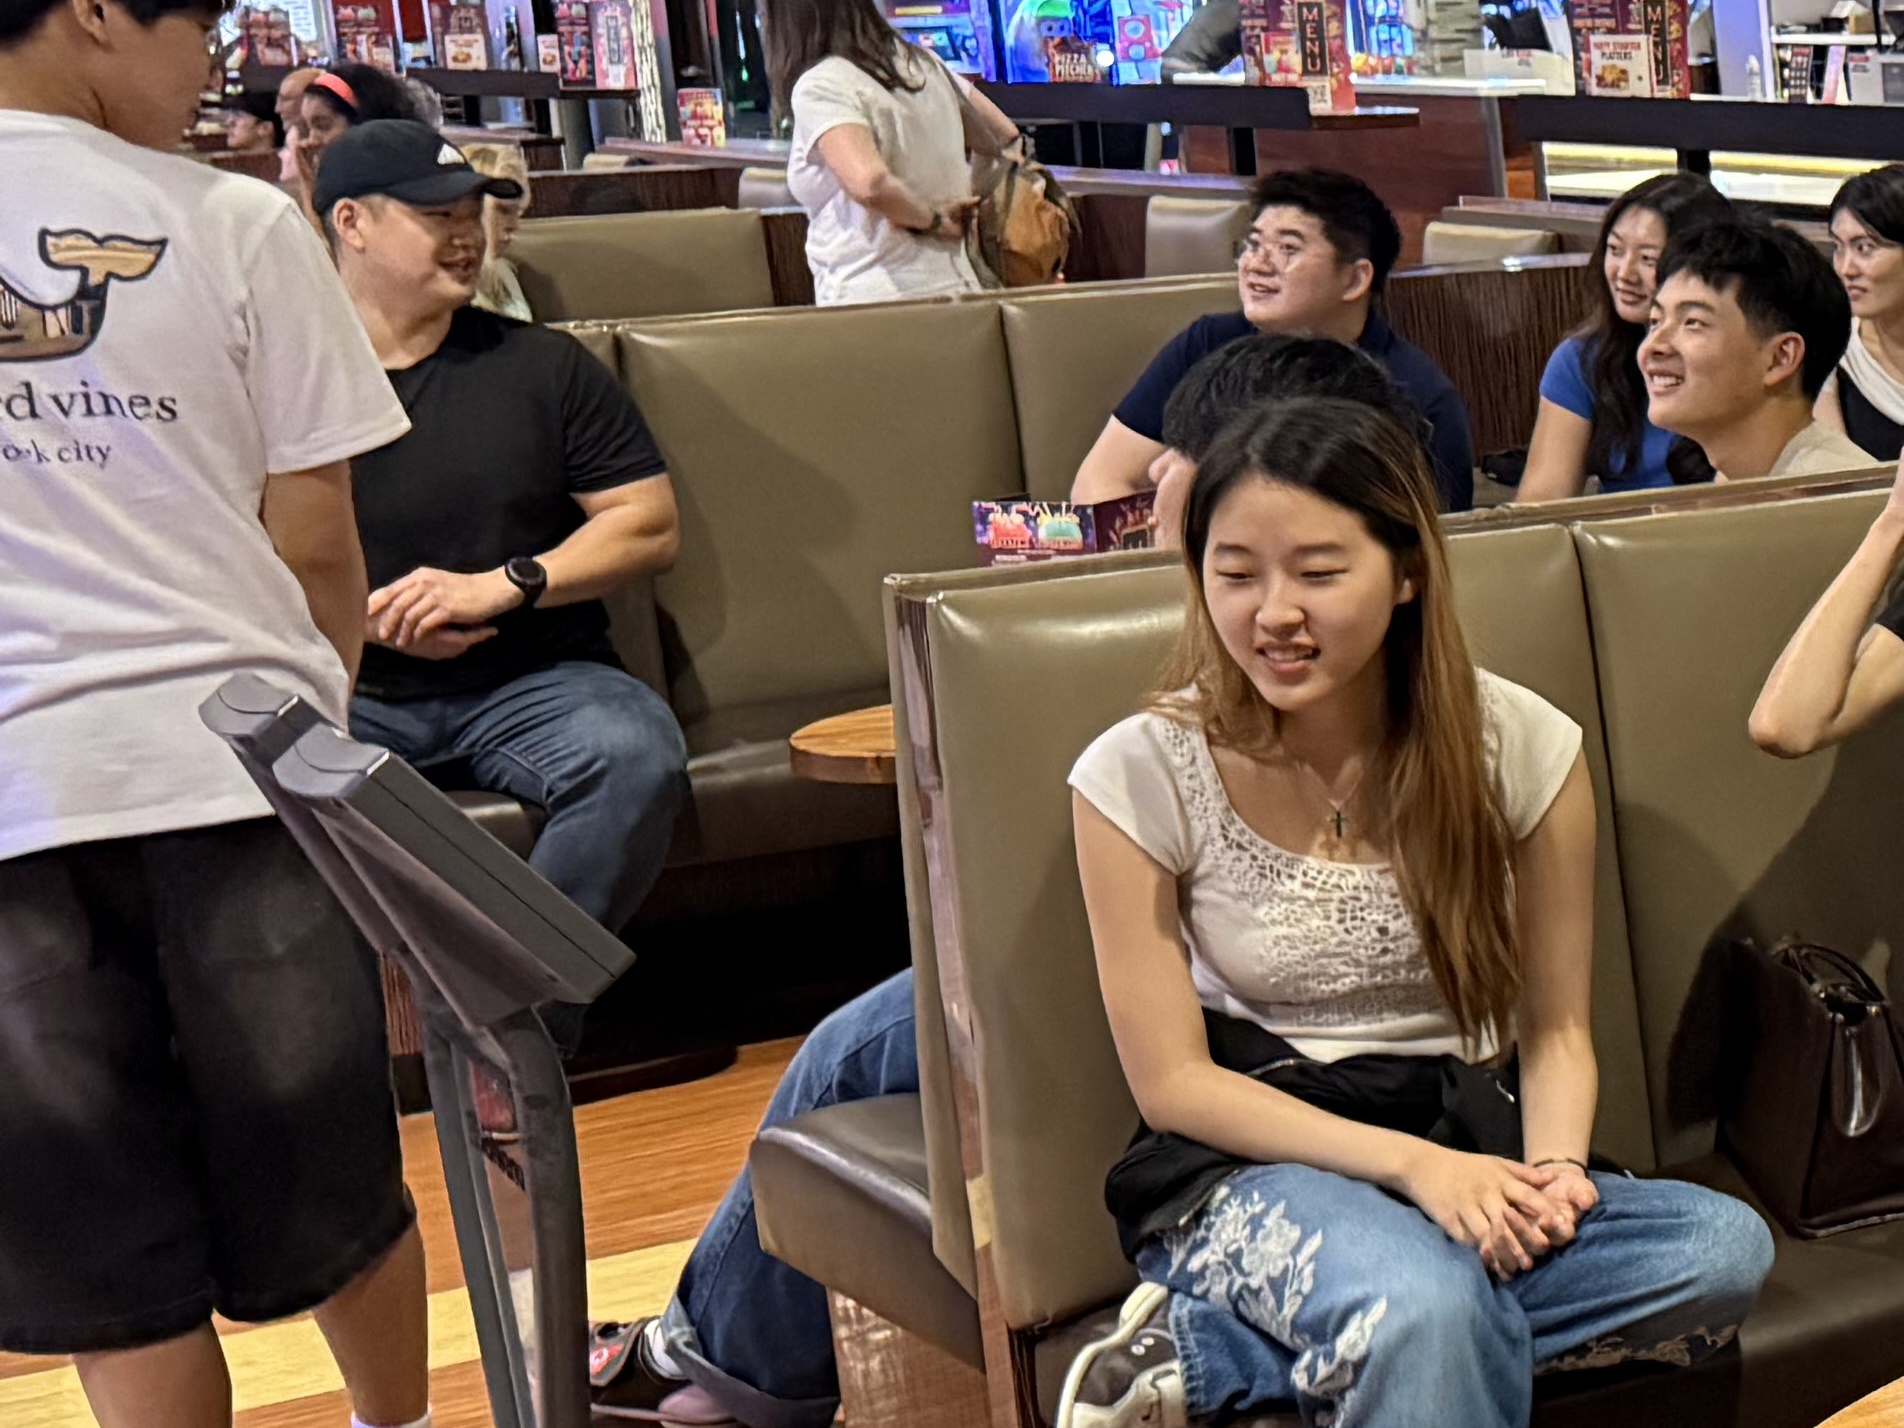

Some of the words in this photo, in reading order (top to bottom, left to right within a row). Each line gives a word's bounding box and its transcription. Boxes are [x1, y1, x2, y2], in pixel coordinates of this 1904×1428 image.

[1302, 6, 1321, 72] MENU
[51, 380, 178, 422] vines
[57, 440, 112, 470] city
